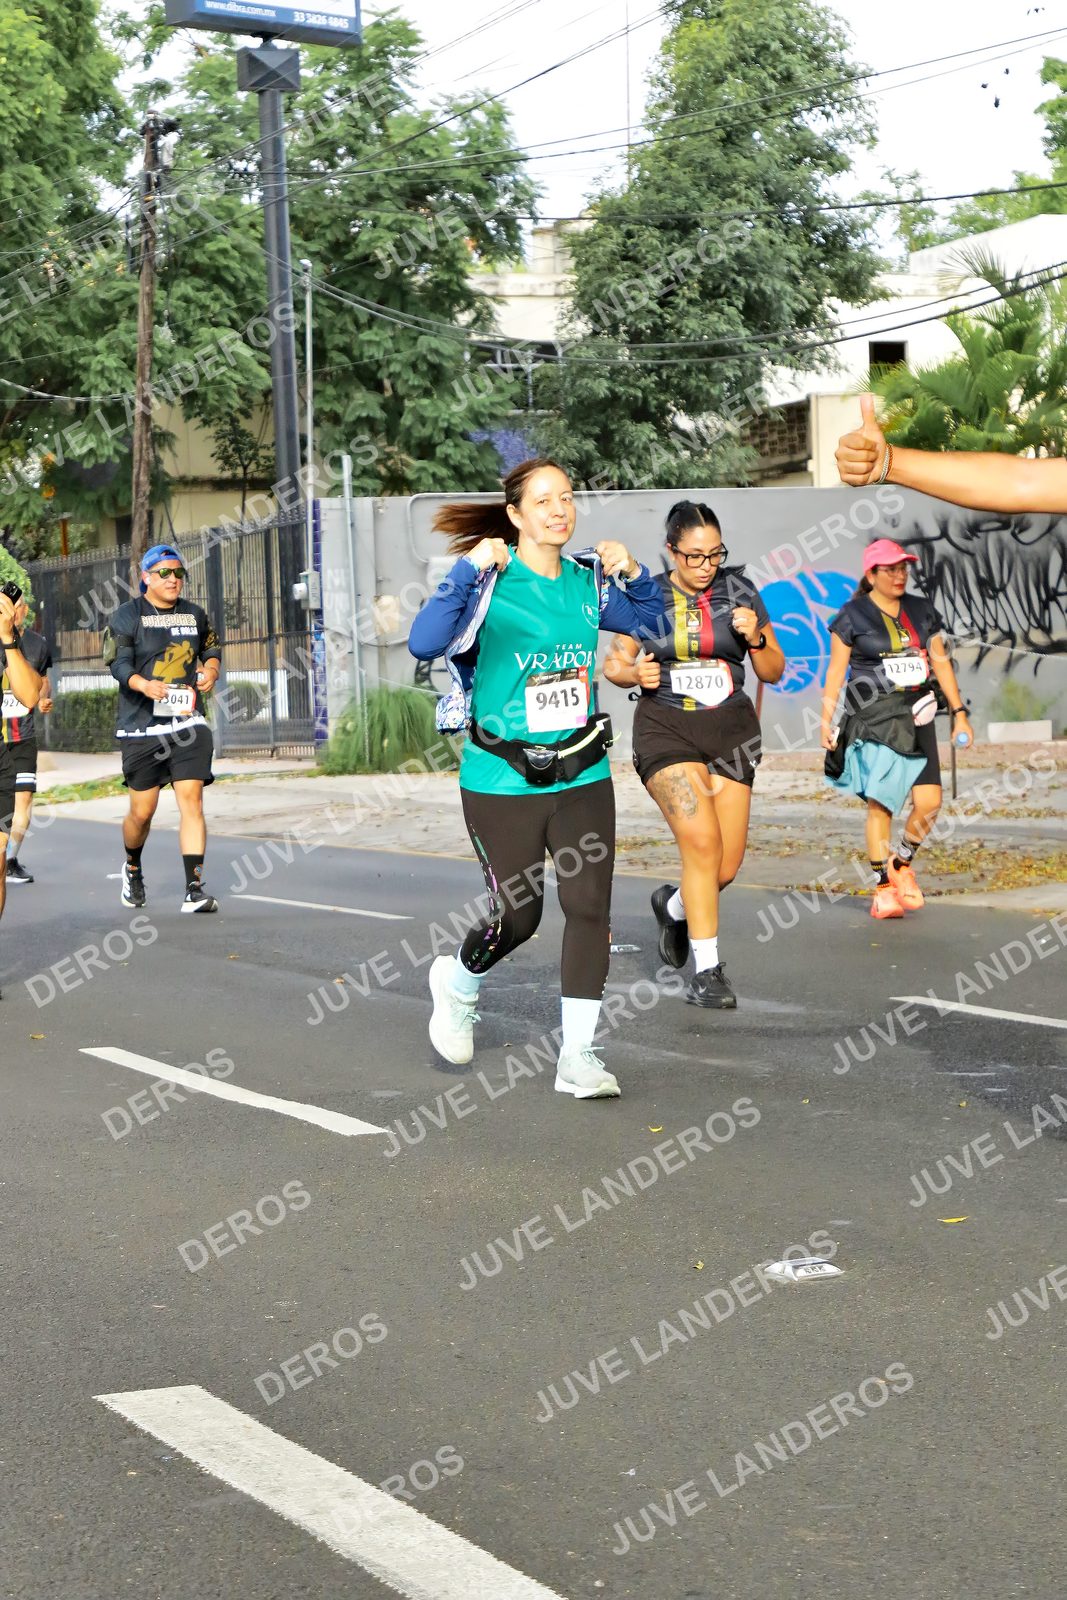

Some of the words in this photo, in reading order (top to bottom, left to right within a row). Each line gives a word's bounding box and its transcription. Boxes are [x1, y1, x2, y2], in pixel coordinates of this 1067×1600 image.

[888, 662, 922, 673] 12794
[675, 675, 724, 690] 12870
[536, 687, 580, 710] 9415
